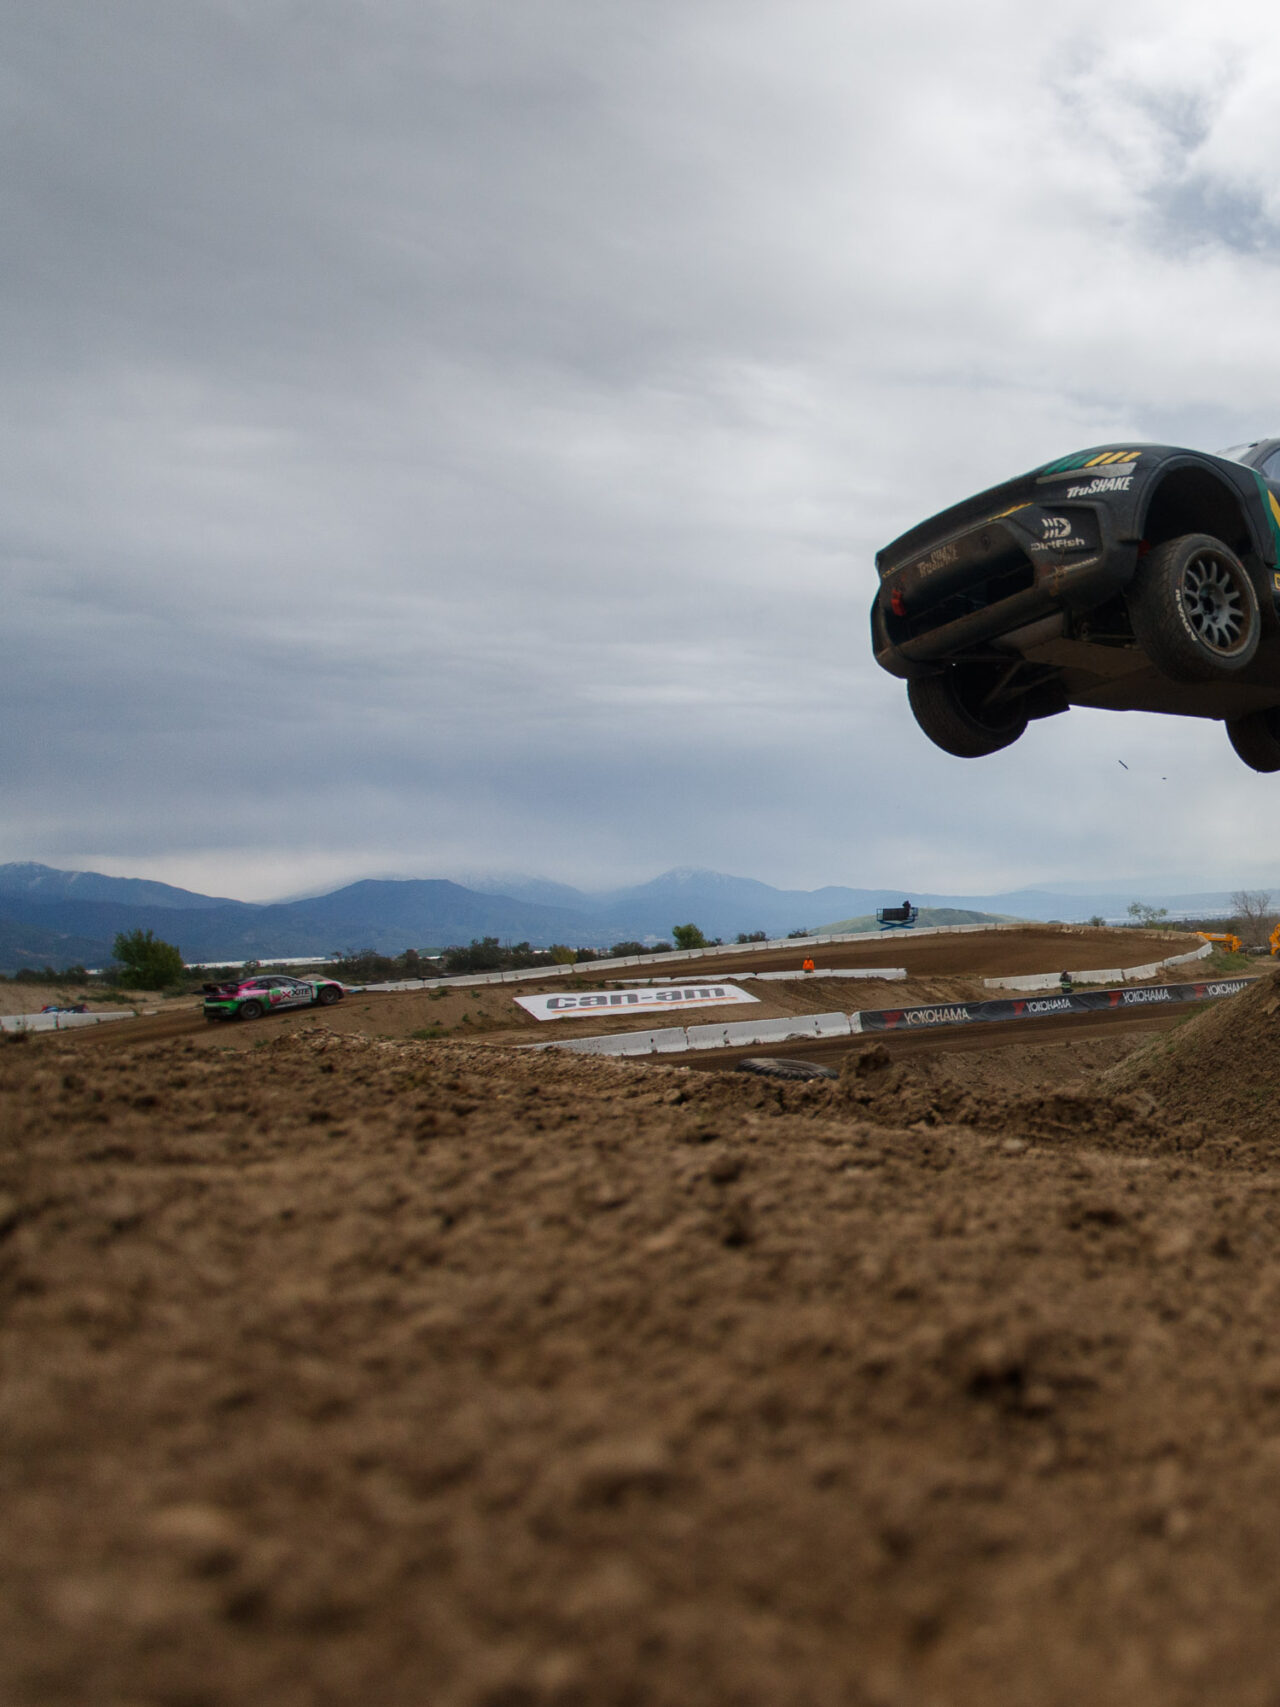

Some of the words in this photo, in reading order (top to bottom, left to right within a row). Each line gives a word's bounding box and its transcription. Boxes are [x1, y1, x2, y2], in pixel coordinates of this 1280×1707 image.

[1066, 476, 1134, 499] TruSHAKE
[1031, 537, 1085, 552] DirtFish
[1122, 988, 1170, 1004] YOKOHAMA
[1026, 998, 1072, 1013] YOKOHAMA
[904, 1007, 971, 1025] YOKOHAMA
